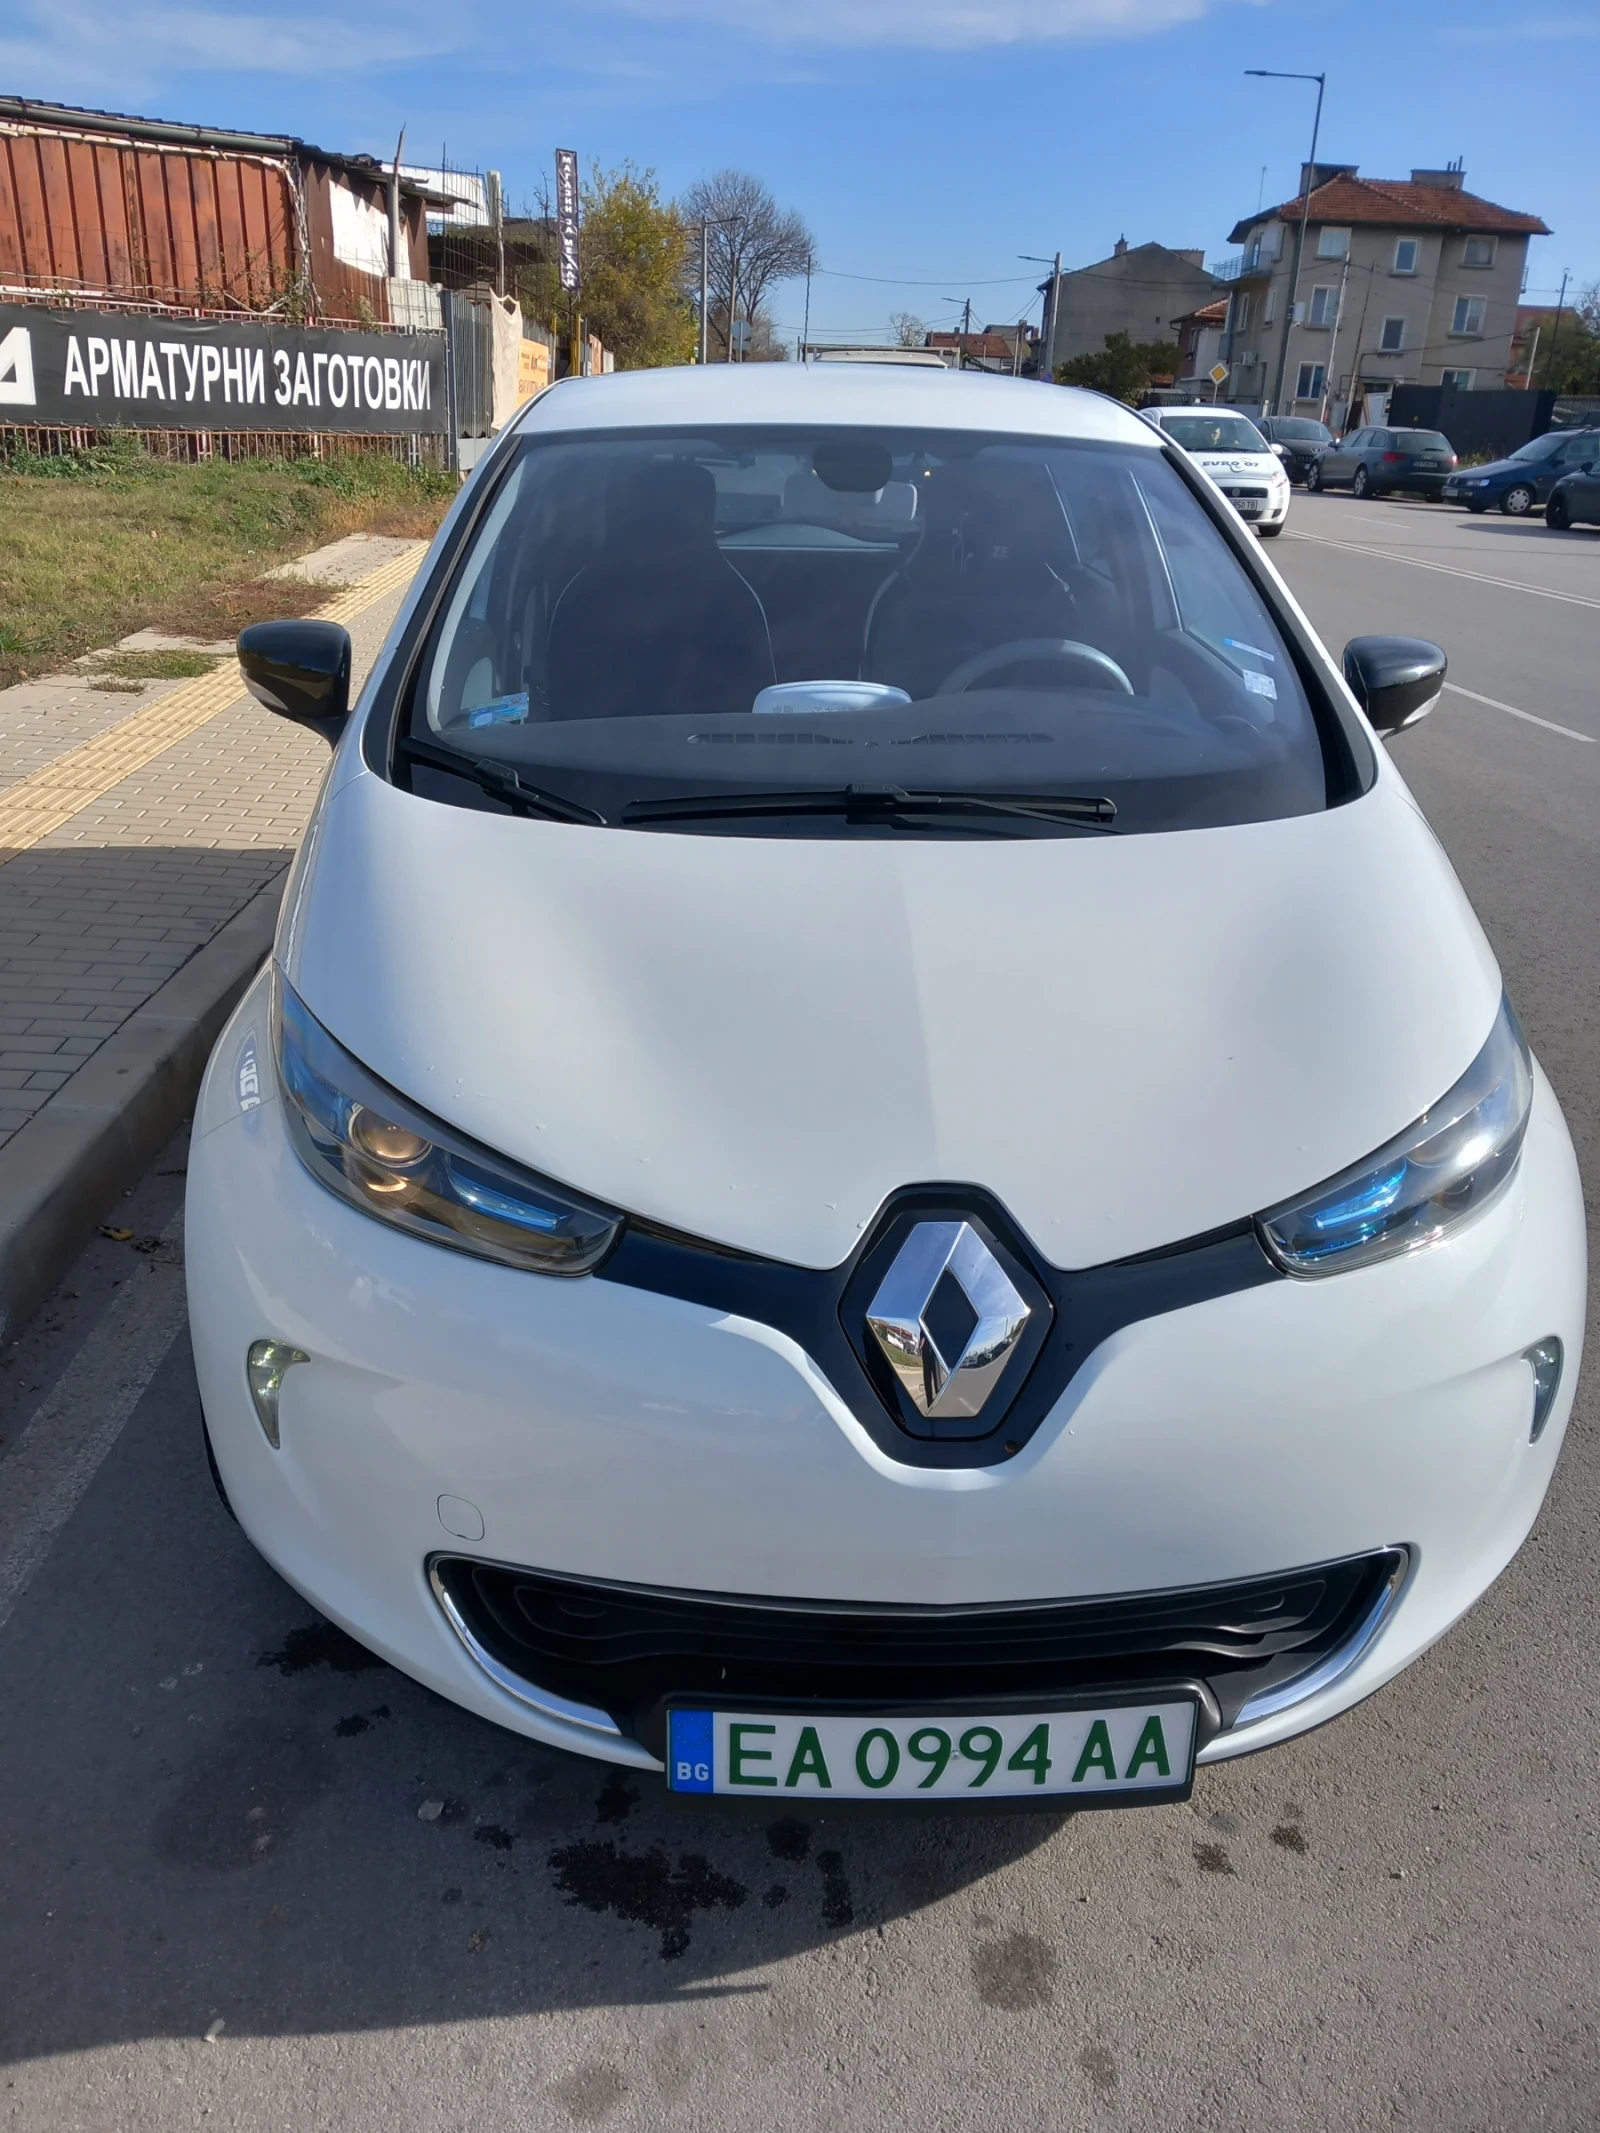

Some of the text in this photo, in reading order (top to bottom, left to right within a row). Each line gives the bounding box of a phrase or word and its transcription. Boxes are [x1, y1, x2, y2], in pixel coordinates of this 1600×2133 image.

[562, 156, 572, 213] МАГАЗИН
[565, 219, 573, 233] ЗА
[63, 335, 266, 404] АРМАТУРНИ
[273, 349, 431, 410] ЗАГОТОВКИ
[676, 1761, 709, 1781] BG
[729, 1715, 1171, 1789] EA 0994 AA
